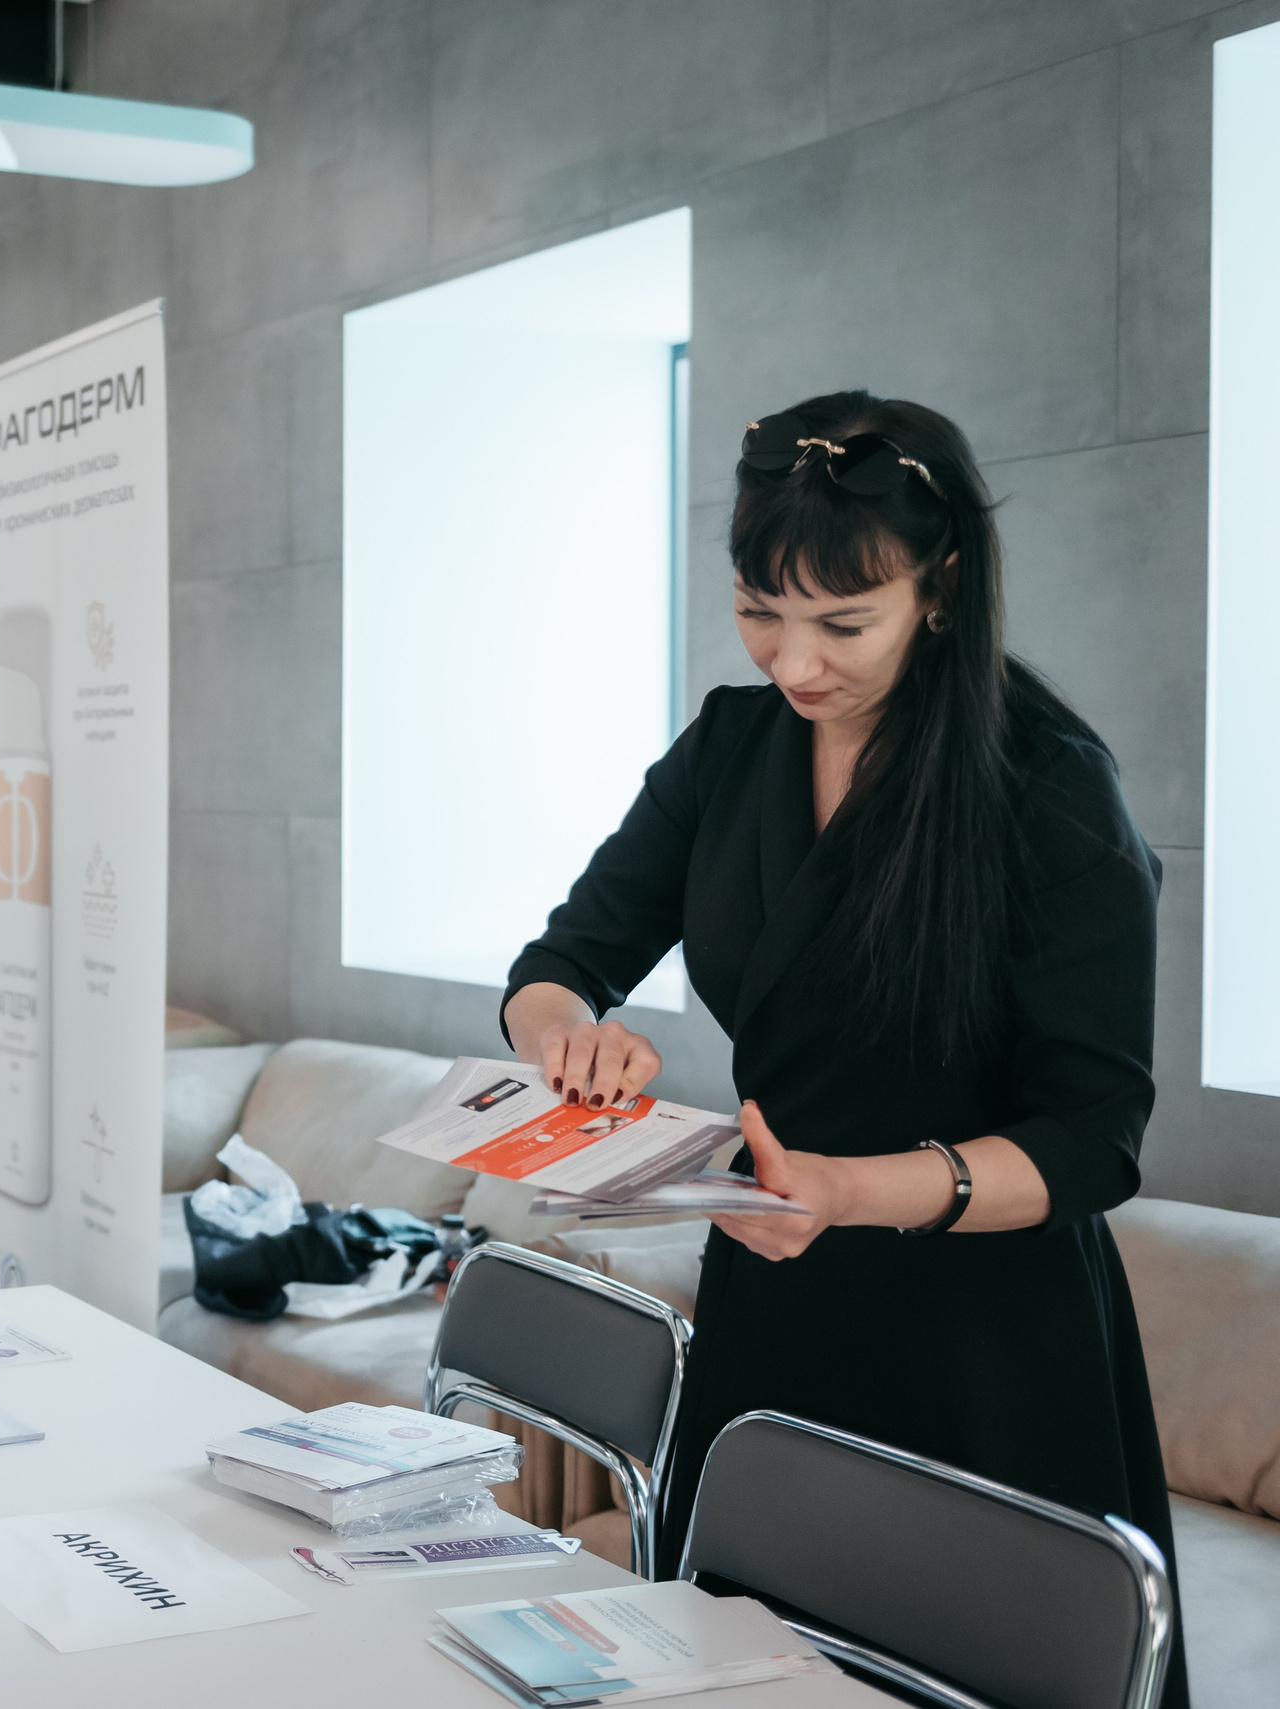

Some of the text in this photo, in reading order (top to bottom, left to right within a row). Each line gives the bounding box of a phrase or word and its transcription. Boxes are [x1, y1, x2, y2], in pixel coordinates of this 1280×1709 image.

[418, 1532, 581, 1555] 4 НЕДЕЛИ
[52, 1532, 187, 1611] АКРИХИН
